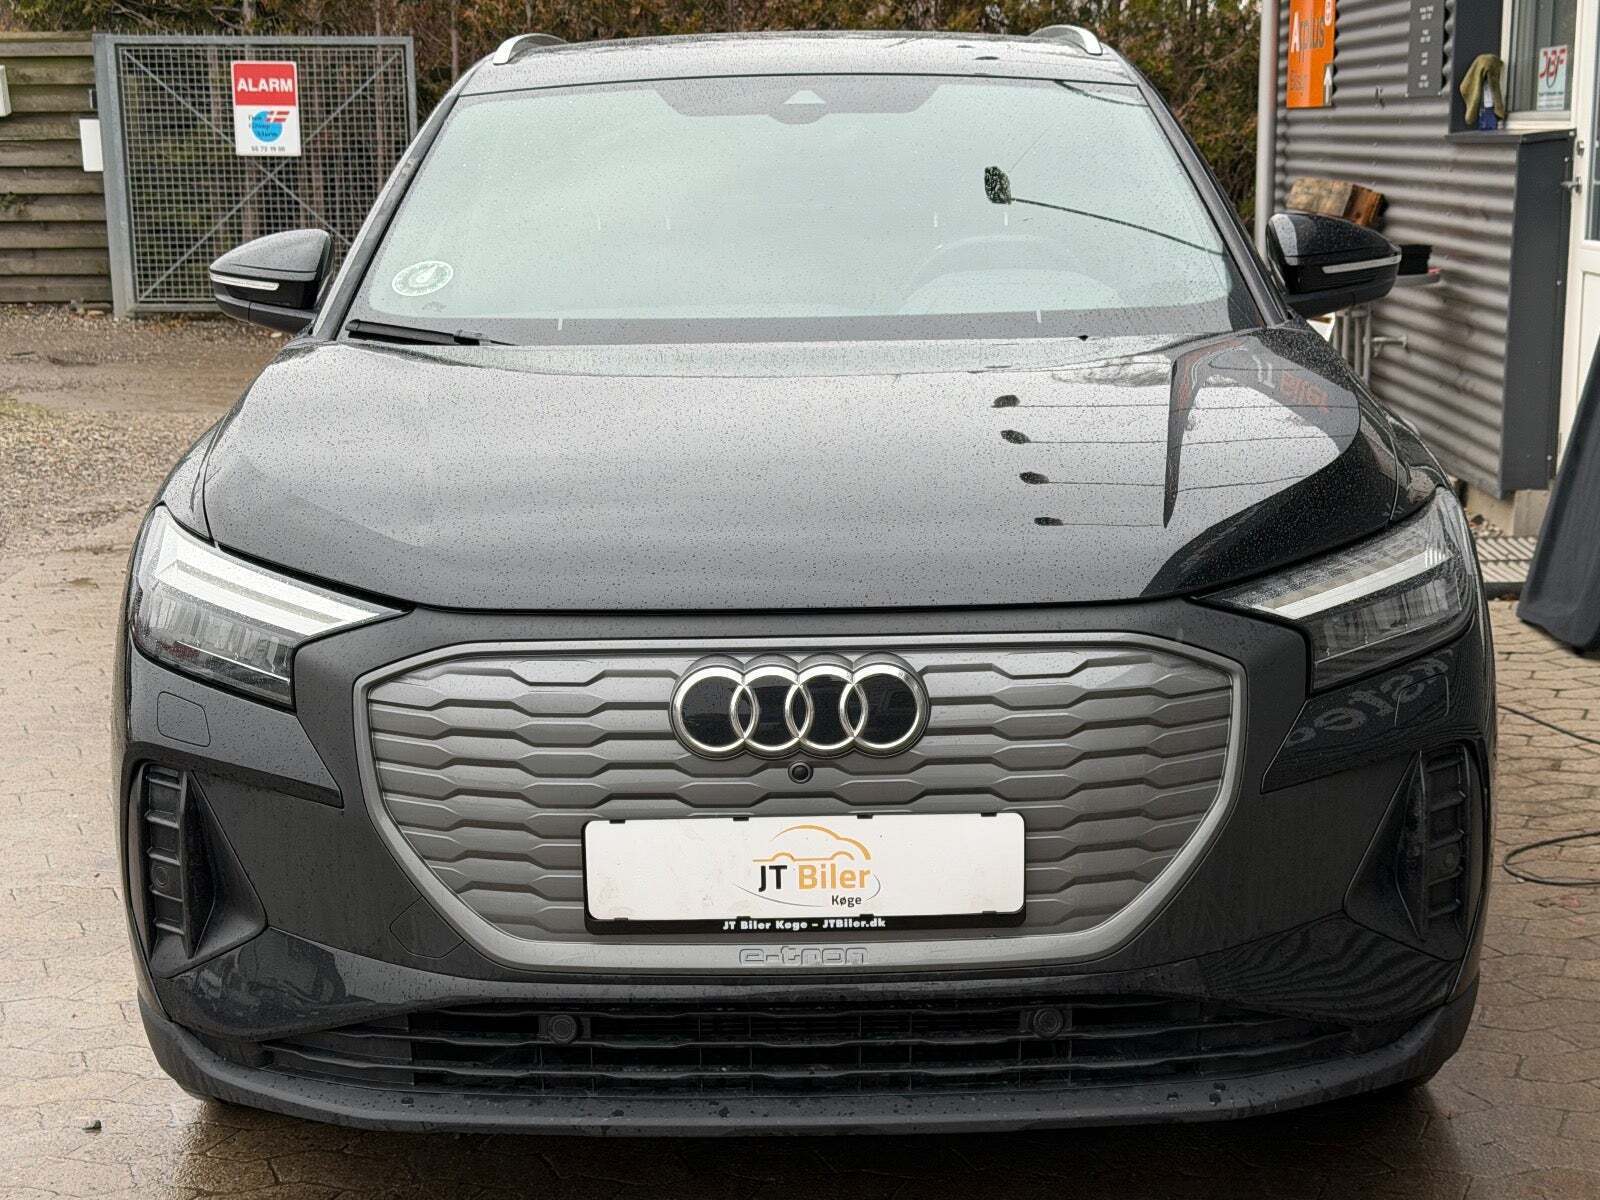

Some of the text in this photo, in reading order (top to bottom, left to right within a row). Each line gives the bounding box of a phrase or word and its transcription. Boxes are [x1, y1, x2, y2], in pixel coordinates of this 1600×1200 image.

[237, 78, 293, 93] ALARM
[758, 863, 871, 892] JT Biler
[831, 894, 862, 908] Køge
[723, 920, 736, 930] JT
[740, 920, 771, 930] Biler
[822, 918, 886, 930] JTBiler.dk
[739, 946, 868, 966] e-tron
